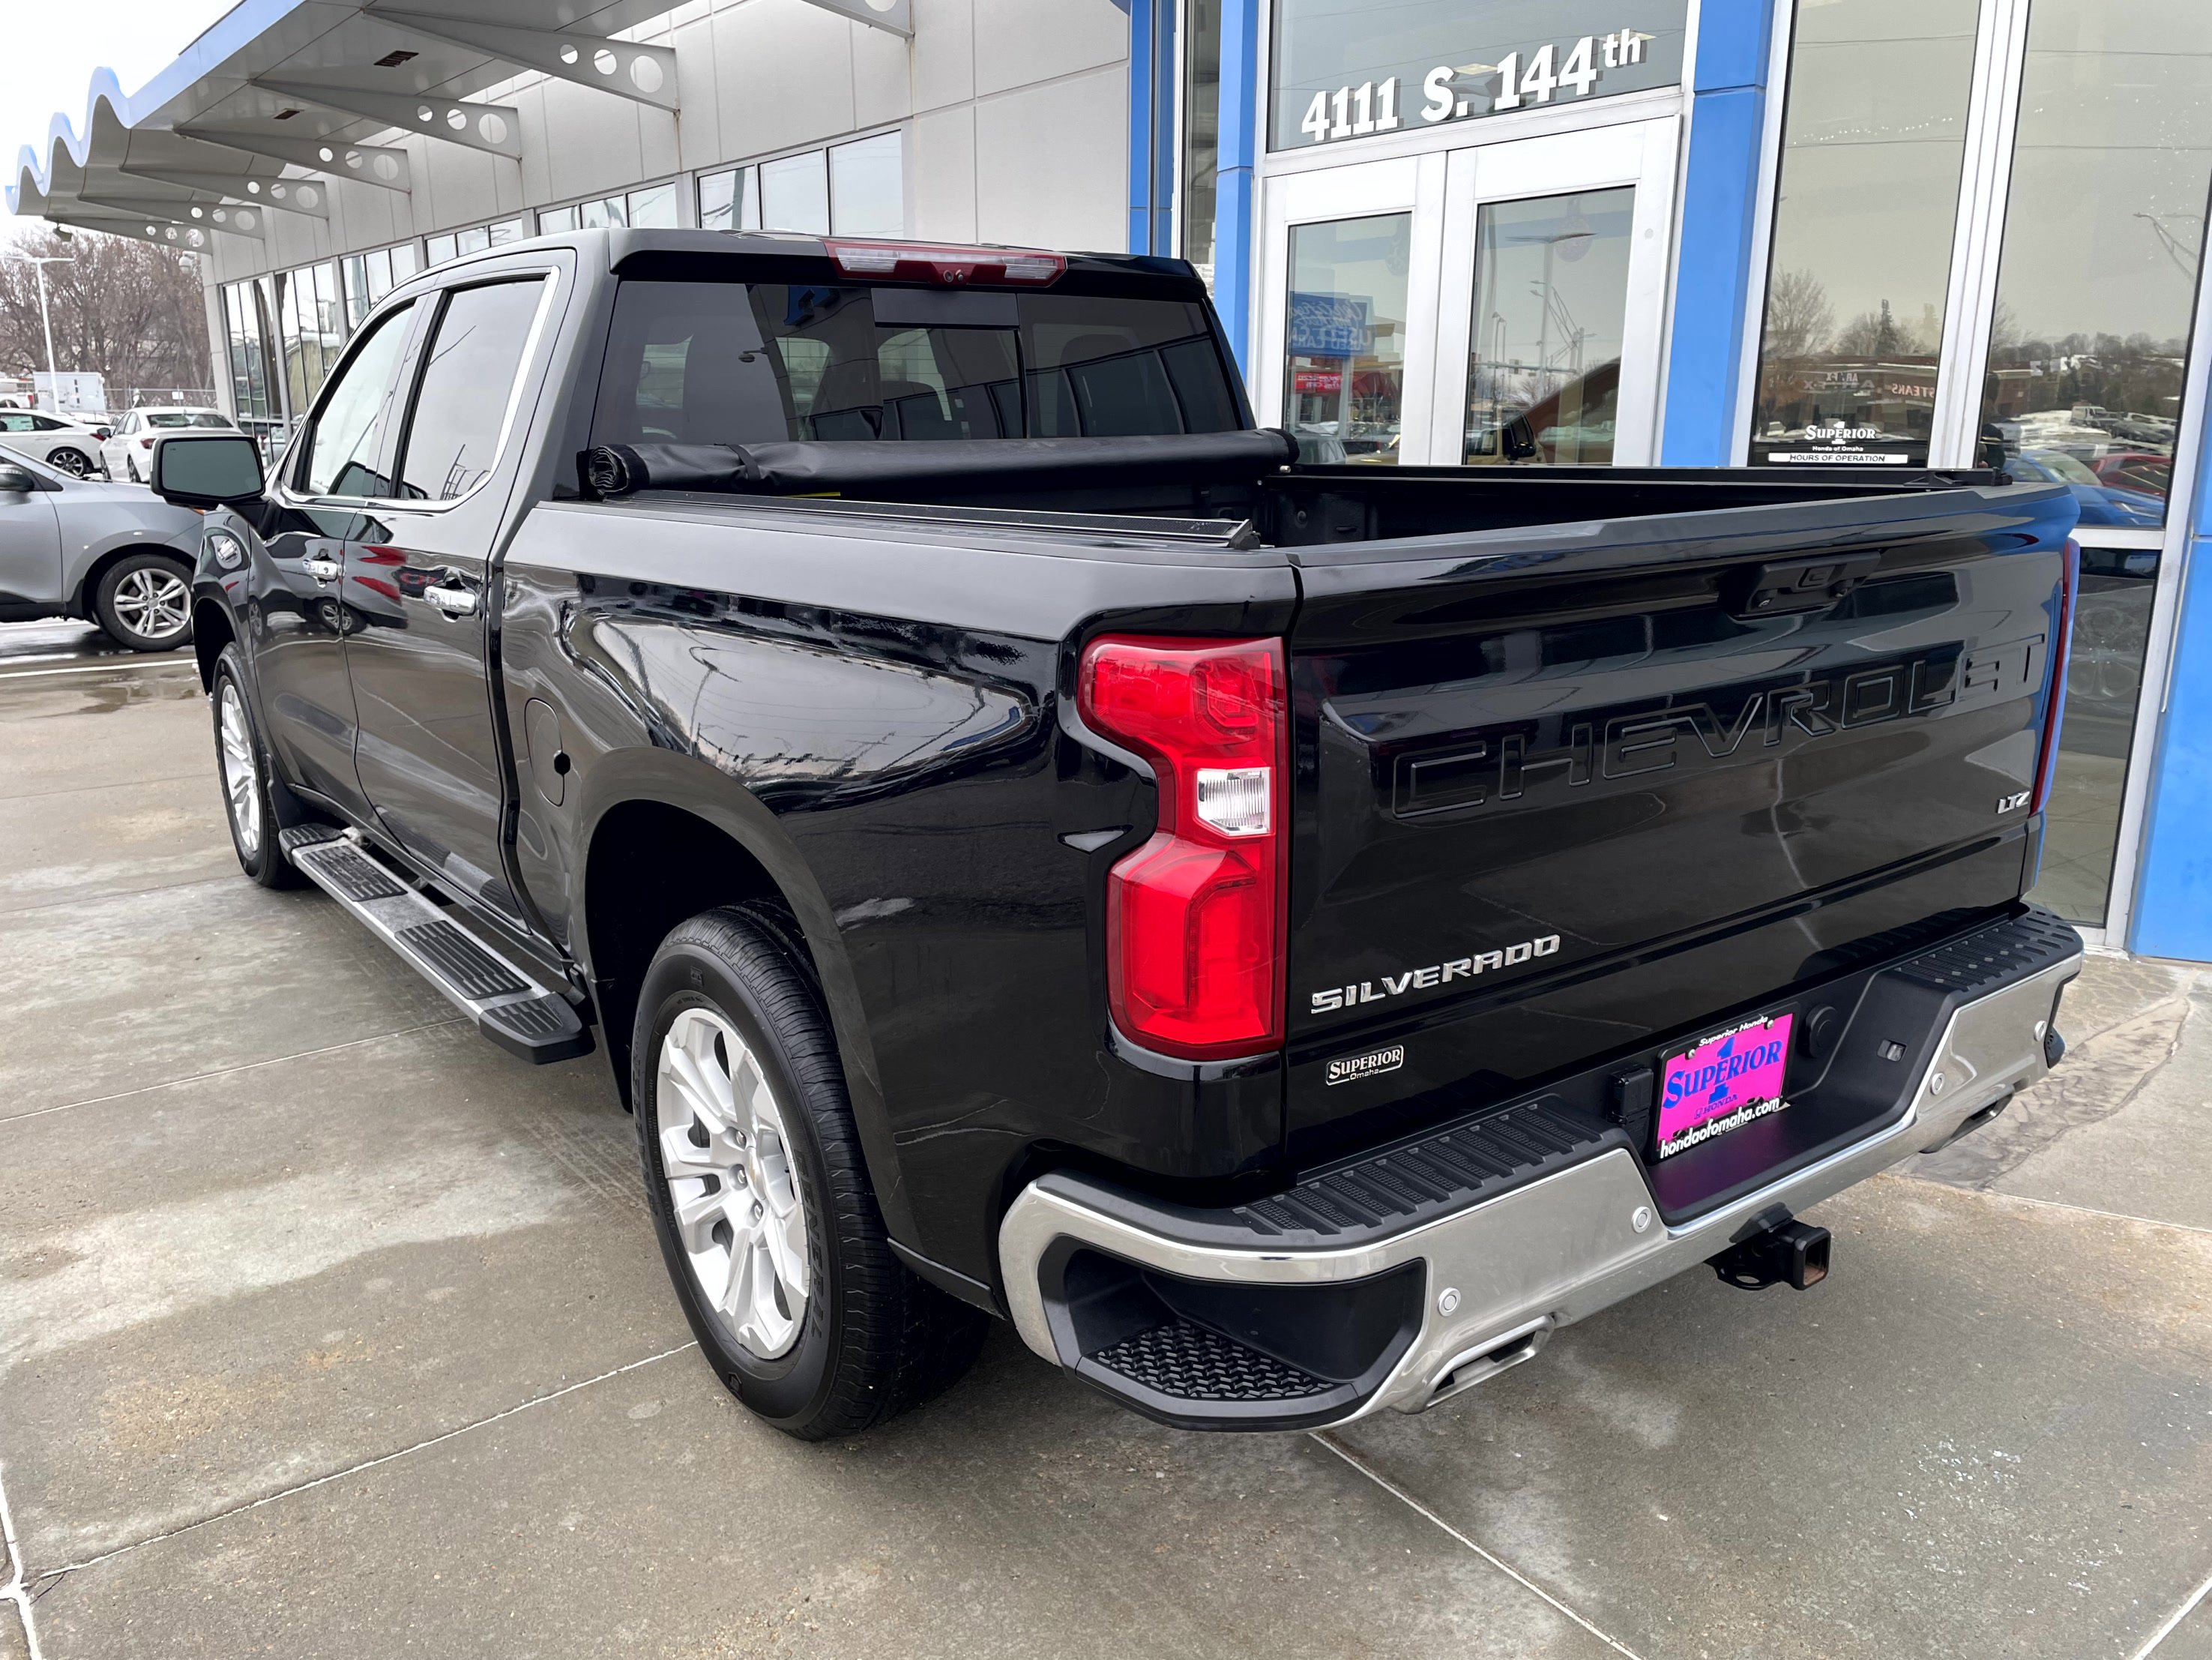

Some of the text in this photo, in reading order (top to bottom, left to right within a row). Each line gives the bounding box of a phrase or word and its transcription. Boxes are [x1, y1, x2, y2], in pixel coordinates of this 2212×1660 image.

[1301, 76, 1399, 141] 4111
[1420, 66, 1468, 121] S.
[1804, 425, 1876, 441] SUPERIOR
[1392, 633, 2046, 818] CHEVROLET
[1997, 790, 2030, 814] LTZ
[1310, 933, 1561, 1014] SILVERADO
[1698, 1015, 1768, 1047] Superior Honda
[1328, 1049, 1401, 1080] SUPERIOR
[1350, 1068, 1380, 1080] Omaha
[1663, 1040, 1782, 1109] SUPERIOR
[1703, 1095, 1738, 1113] HONDA
[1660, 1097, 1780, 1159] hondaofomaha.com
